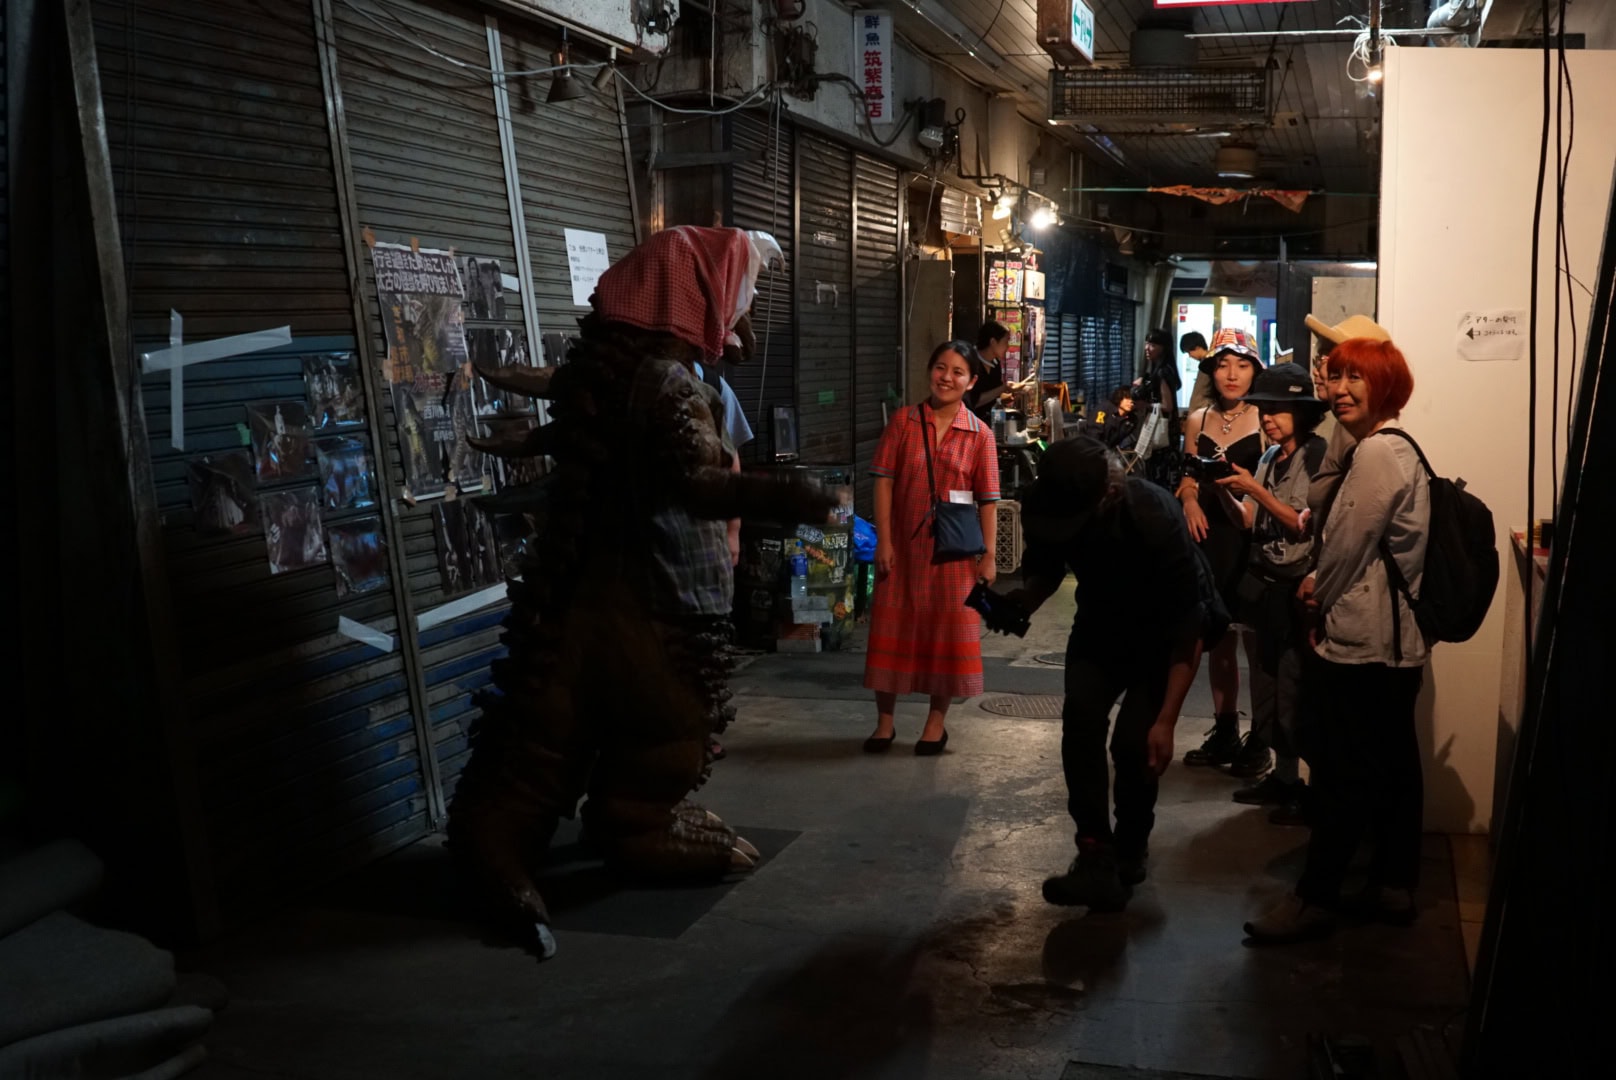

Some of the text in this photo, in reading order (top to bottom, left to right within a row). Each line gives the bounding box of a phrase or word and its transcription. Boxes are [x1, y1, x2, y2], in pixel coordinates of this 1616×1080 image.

[863, 15, 883, 118] 鮮魚 筑紫商店
